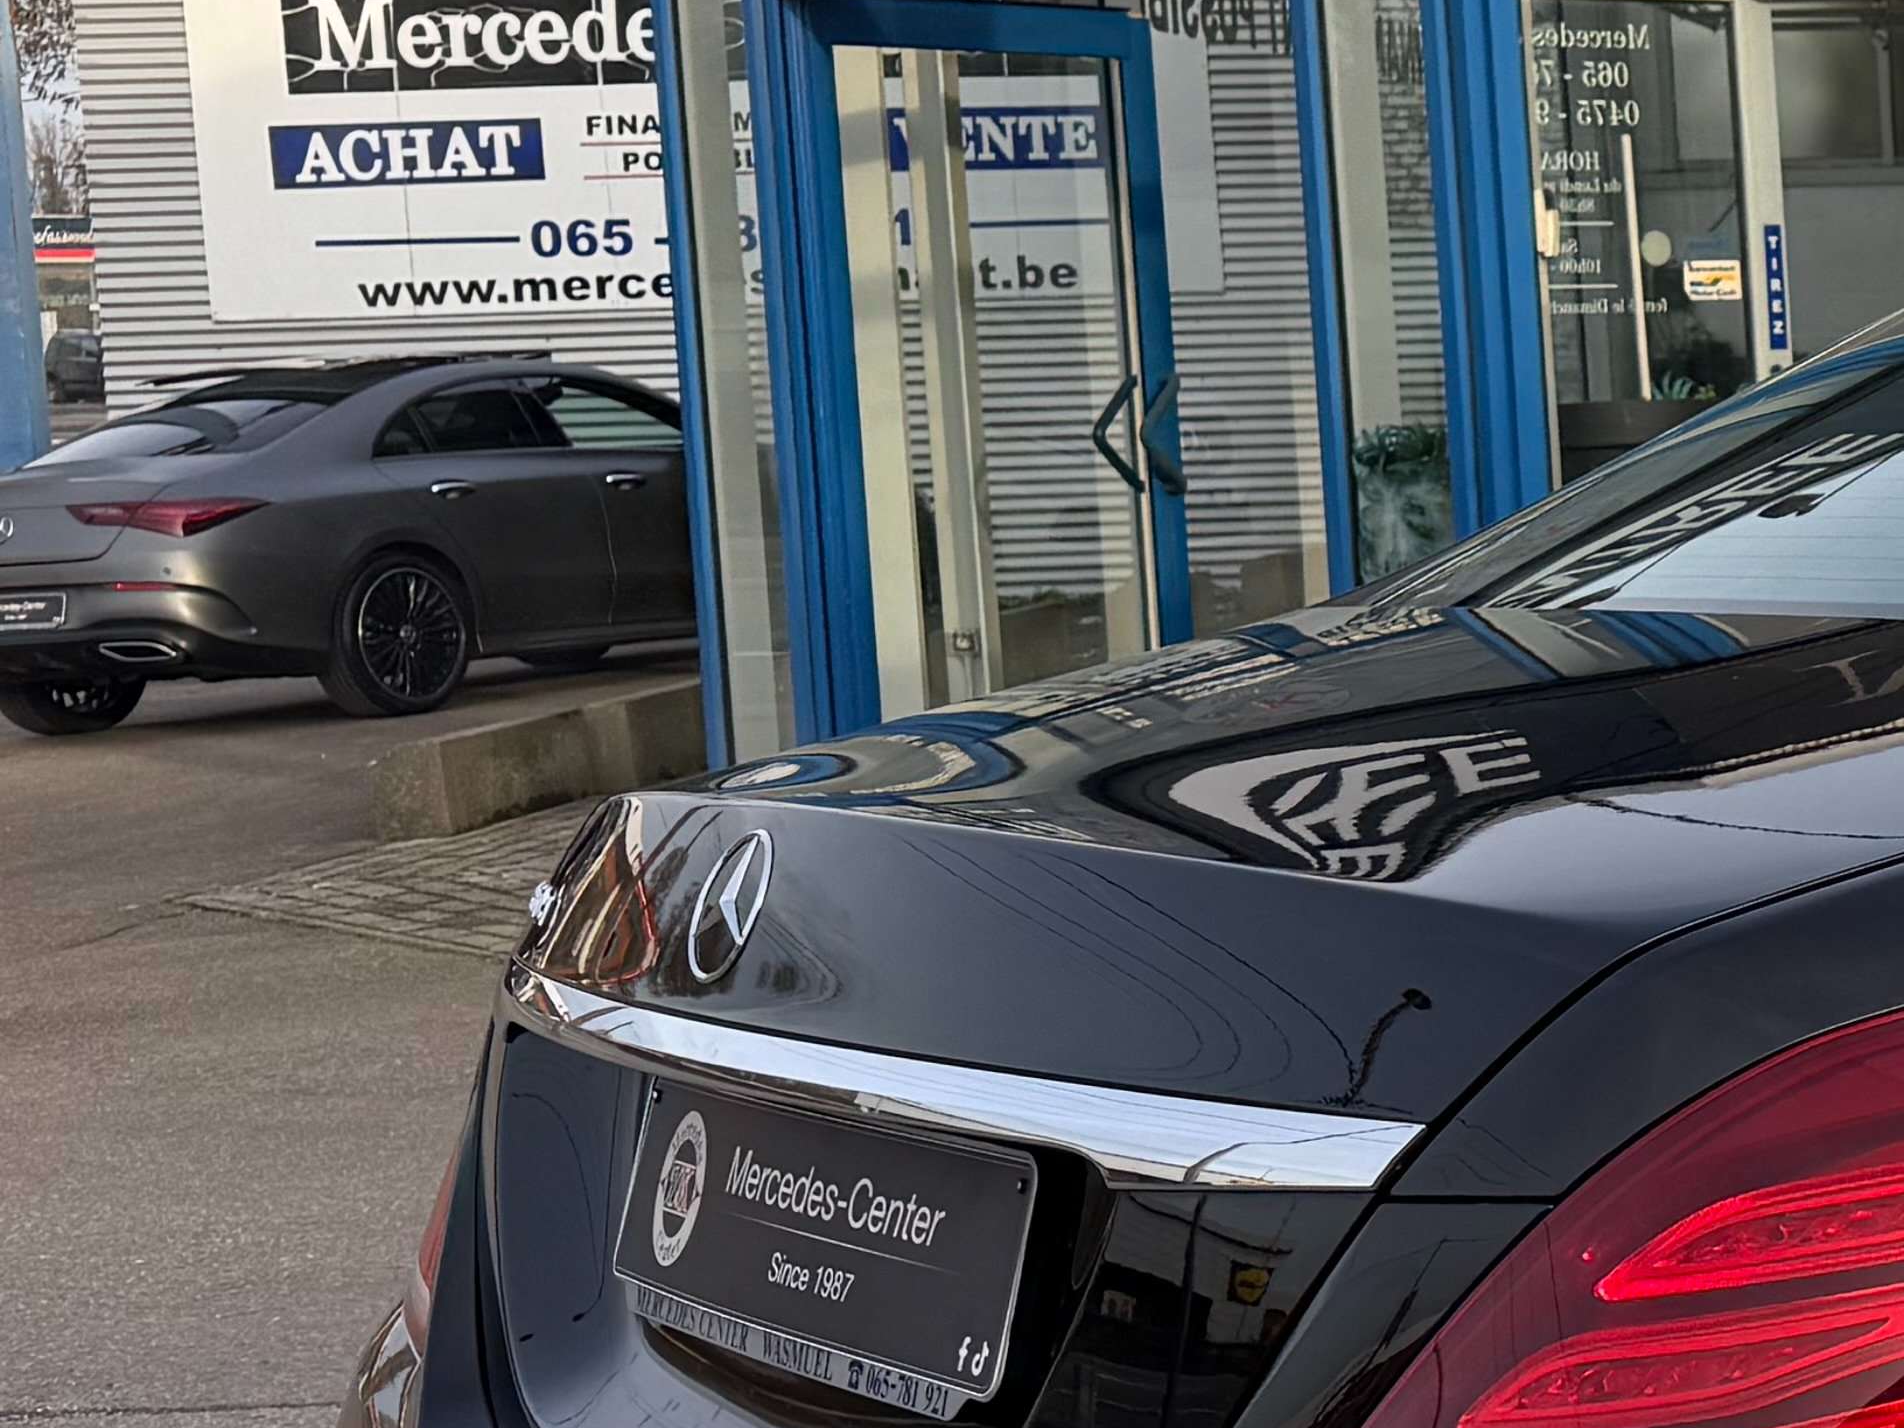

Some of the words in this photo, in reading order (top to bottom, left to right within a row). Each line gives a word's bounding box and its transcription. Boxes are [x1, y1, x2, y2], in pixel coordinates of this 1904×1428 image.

[295, 124, 521, 184] ACHAT
[529, 218, 634, 258] 065
[1767, 235, 1785, 335] TIREZ
[725, 1145, 947, 1248] Mercedes-Center
[768, 1252, 810, 1291] Since
[813, 1265, 856, 1303] 1987
[636, 1284, 697, 1331] MERCEDES
[699, 1309, 750, 1352] CENTER
[762, 1327, 833, 1382] WASMUEL
[865, 1370, 918, 1408] 065-781
[924, 1386, 950, 1418] 921
